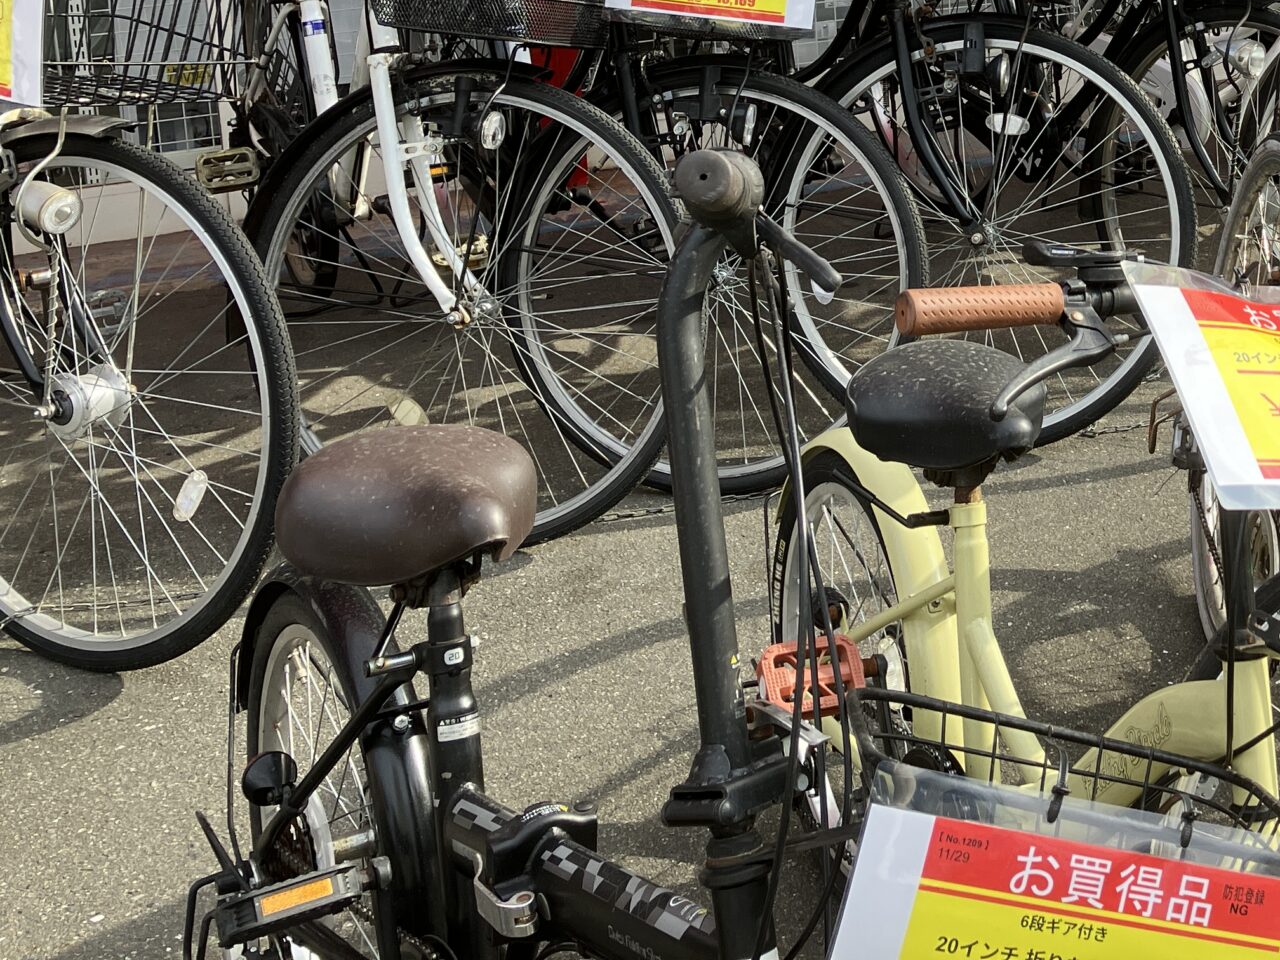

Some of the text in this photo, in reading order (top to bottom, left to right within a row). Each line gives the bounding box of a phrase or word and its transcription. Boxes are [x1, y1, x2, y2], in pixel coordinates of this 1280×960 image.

[938, 847, 970, 863] 11/29
[1009, 845, 1212, 927] お買得品
[1222, 883, 1265, 906] 防犯登録
[1229, 903, 1249, 916] NG
[1020, 914, 1107, 942] 6段ギア付き
[935, 936, 1019, 960] 20インチ
